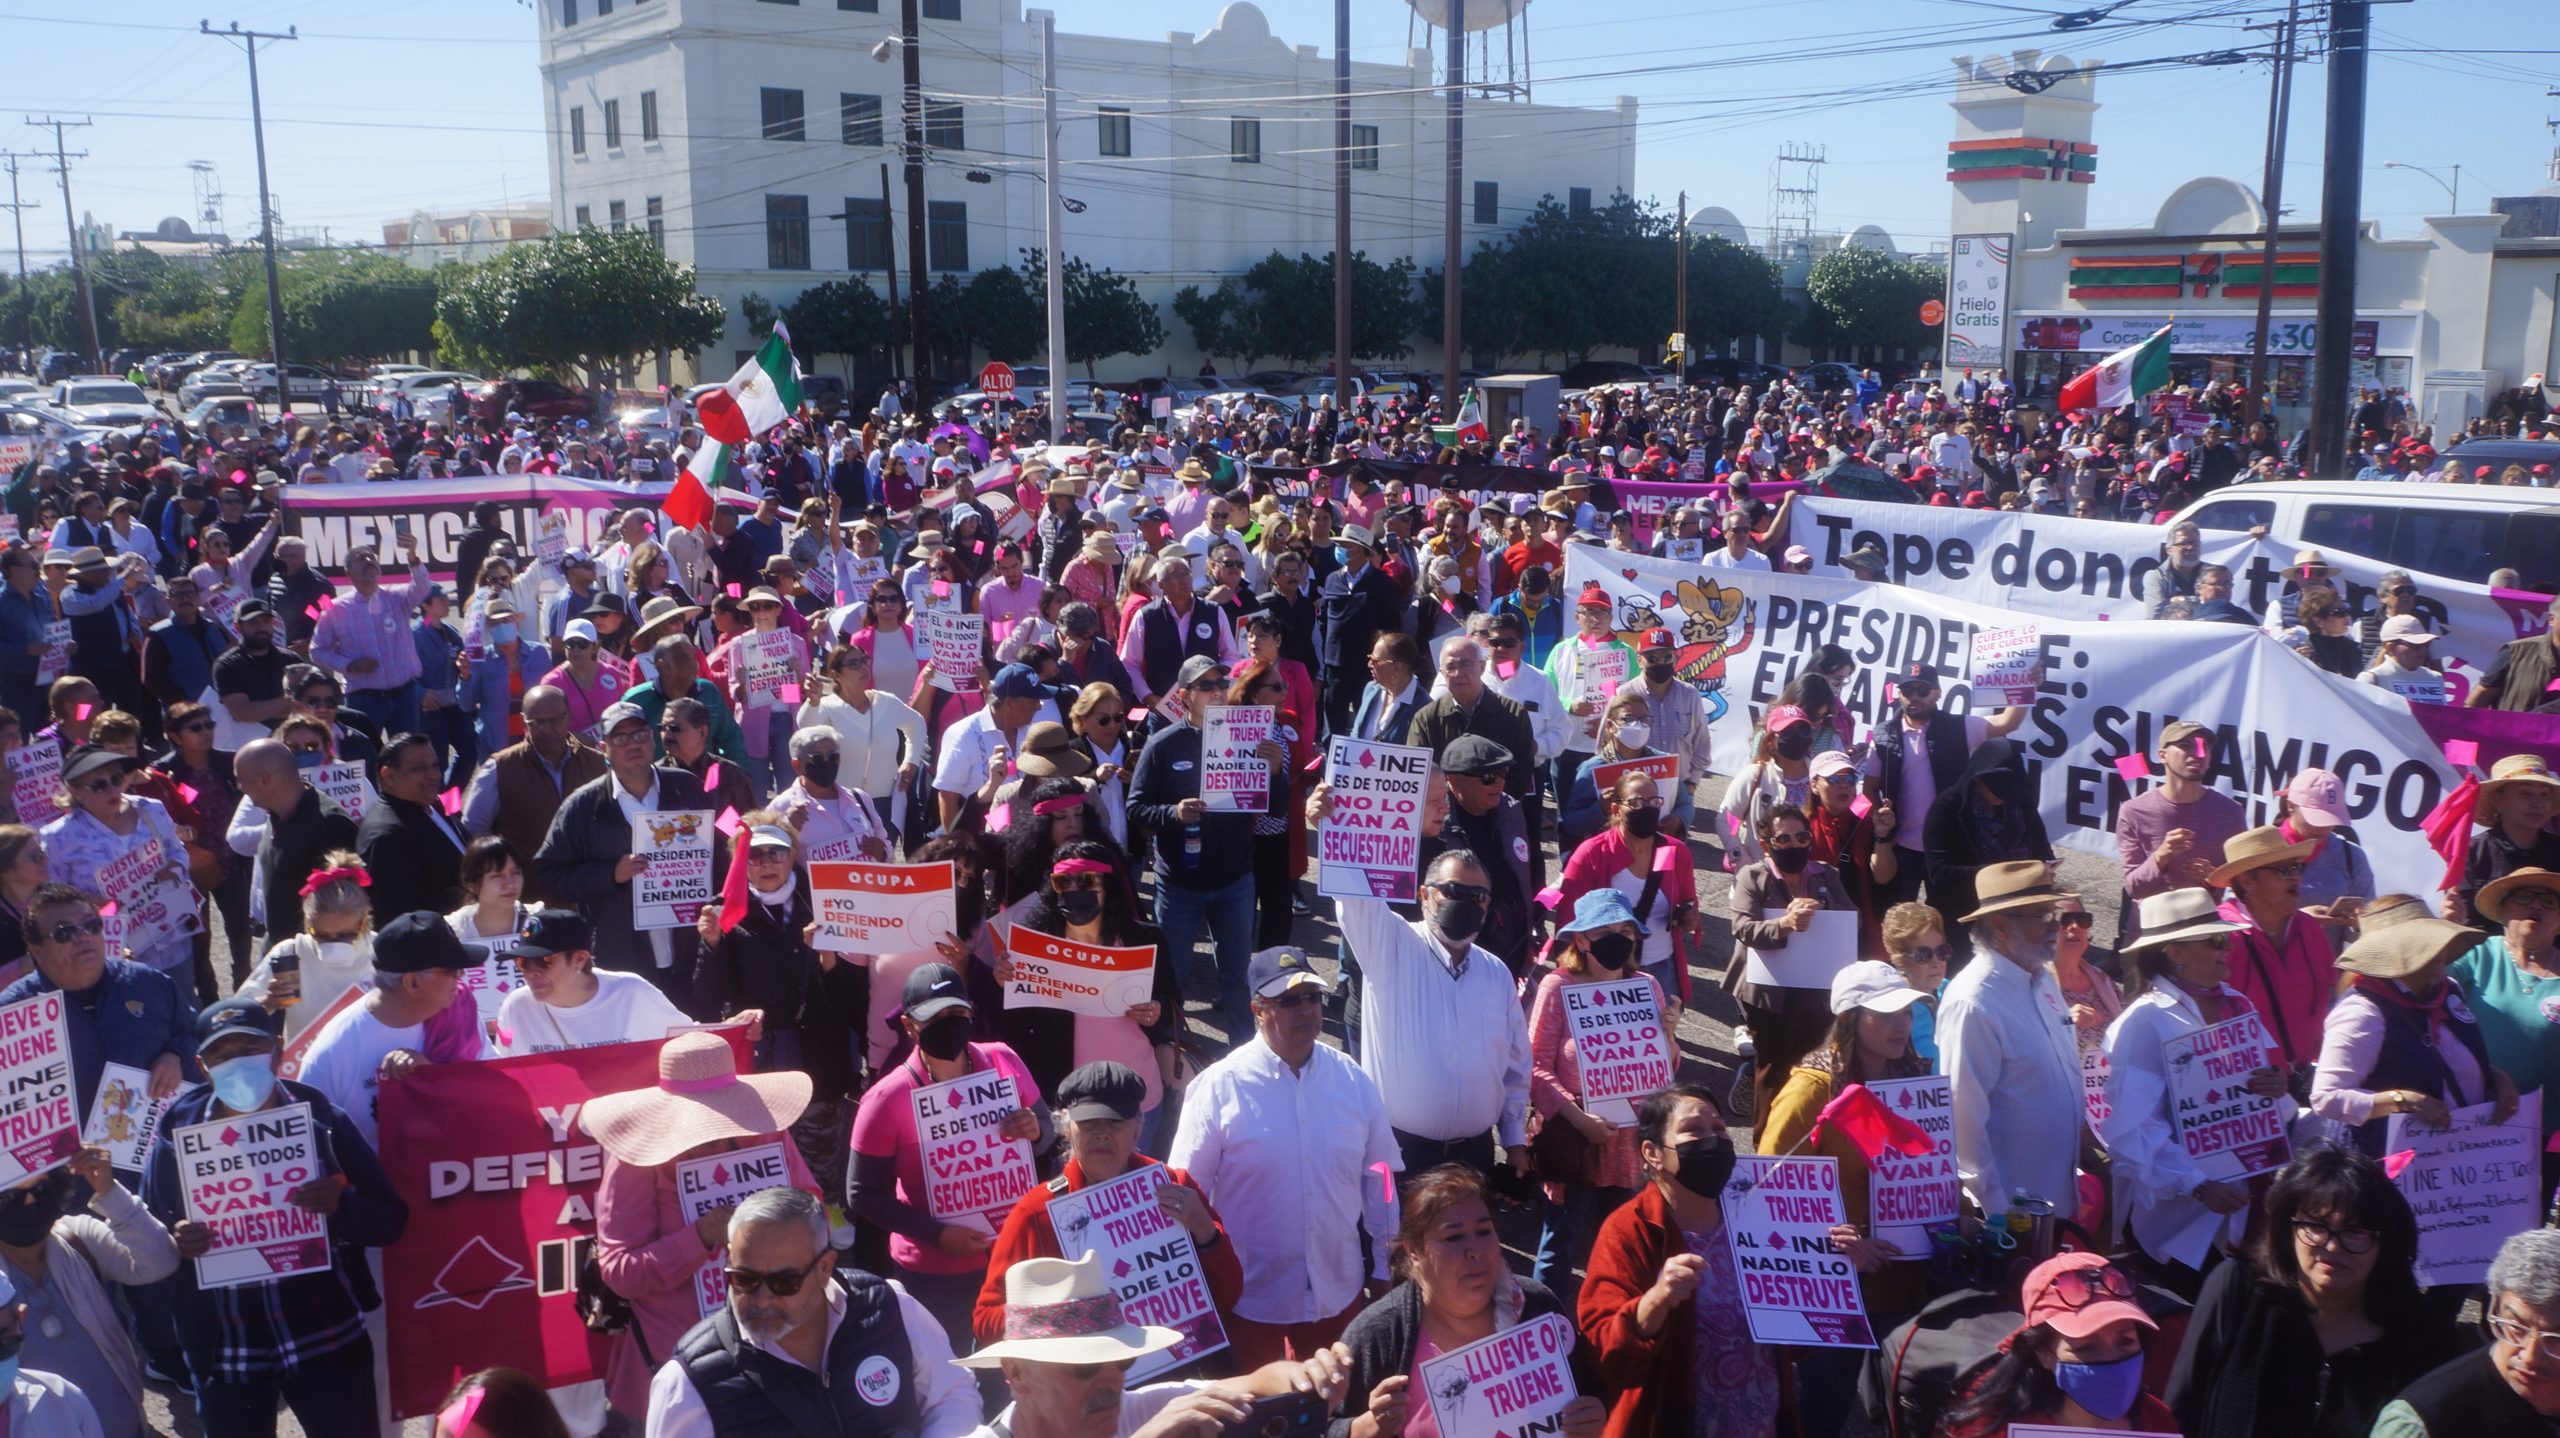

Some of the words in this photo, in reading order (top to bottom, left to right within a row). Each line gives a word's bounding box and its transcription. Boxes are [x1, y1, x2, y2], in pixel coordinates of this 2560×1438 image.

[1960, 297, 1996, 311] Hielo
[1955, 313, 2000, 327] Gratis
[2183, 321, 2205, 329] sabor
[2270, 323, 2317, 350] $30
[983, 374, 1013, 389] ALTO
[1272, 477, 1308, 497] Sin
[300, 507, 535, 567] MEXICLI
[1816, 514, 1974, 586] Tope
[956, 620, 981, 630] INE
[1977, 629, 2016, 644] CUESTE
[2022, 625, 2036, 635] LO
[954, 633, 979, 641] TODOS
[960, 643, 978, 651] LO
[1763, 594, 2089, 699] PRESIDENE:
[1976, 642, 1996, 653] QUE
[1998, 635, 2036, 648] CUESTE
[2007, 648, 2038, 658] INE
[2009, 660, 2026, 668] LO
[1600, 664, 1623, 678] TRUENE
[2418, 686, 2442, 696] INE
[1225, 709, 1262, 725] LLUEVE
[1263, 709, 1271, 723] O
[1229, 726, 1266, 742] TRUENE
[34, 743, 58, 762] INE
[1206, 748, 1218, 759] AL
[1333, 745, 1351, 766] EL
[1379, 754, 1427, 775] INE
[333, 767, 362, 782] INE
[1206, 762, 1246, 771] NADIE
[1250, 762, 1267, 771] LO
[1621, 763, 1668, 777] OCUPA
[2204, 724, 2442, 826] AMIGO
[333, 784, 362, 797] TODOS
[1206, 772, 1267, 790] DESTRUYE
[1334, 774, 1349, 788] ES
[1353, 776, 1370, 791] DE
[1374, 778, 1419, 793] TODOS
[340, 797, 362, 808] LO
[1381, 798, 1415, 814] LO
[1329, 812, 1383, 831] VAN
[1391, 816, 1410, 831] A
[812, 839, 852, 862] CUESTE
[1324, 830, 1416, 867] SECUESTRAR!
[100, 854, 141, 883] CUESTE
[143, 839, 158, 857] LO
[655, 861, 691, 870] NARCO
[105, 876, 129, 899] QUE
[129, 854, 166, 884] CUESTE
[643, 871, 658, 879] SU
[660, 869, 694, 878] AMIGO
[644, 881, 655, 890] EL
[675, 878, 704, 887] INE
[848, 871, 915, 887] OCUPA
[642, 888, 708, 903] ENEMIGO
[823, 898, 855, 911] #YO
[825, 911, 904, 929] DEFIENDO
[825, 928, 870, 941] ALINE
[1045, 943, 1116, 966] OCUPA
[1015, 961, 1048, 975] #YO
[1014, 982, 1063, 999] ALINE
[1015, 972, 1099, 996] DEFIENDO
[46, 998, 60, 1022] O
[1568, 993, 1588, 1011] EL
[1610, 986, 1652, 1006] INE
[1579, 1016, 1594, 1029] ES
[1595, 1013, 1613, 1027] DE
[1613, 1008, 1655, 1024] TODOS
[1580, 1031, 1621, 1051] ¡NO
[1627, 1026, 1658, 1041] LO
[2192, 1022, 2247, 1057] LLUEVE
[2247, 1018, 2259, 1040] O
[1585, 1046, 1636, 1064] VAN
[1643, 1042, 1660, 1057] A
[2084, 1055, 2095, 1069] EL
[2203, 1046, 2262, 1081] TRUENE
[9, 1060, 67, 1096] INE
[1586, 1059, 1670, 1098] SECUESTRAR!
[34, 1082, 67, 1104] LO
[919, 1097, 942, 1119] EL
[968, 1079, 1014, 1108] INE
[1916, 1087, 1949, 1110] INE
[2179, 1097, 2199, 1112] AL
[538, 1103, 581, 1143] Y
[931, 1122, 947, 1141] ES
[950, 1117, 970, 1136] DE
[972, 1104, 1014, 1131] TODOS
[1918, 1115, 1950, 1134] TODOS
[2182, 1104, 2243, 1129] NADIE
[2249, 1097, 2273, 1112] LO
[183, 1132, 212, 1155] EL
[247, 1115, 307, 1144] INE
[2185, 1109, 2281, 1157] DESTRUYE
[195, 1160, 216, 1177] ES
[221, 1155, 244, 1172] DE
[247, 1144, 306, 1168] TODOS
[928, 1138, 977, 1168] ¡NO
[934, 1154, 993, 1180] VAN
[1001, 1147, 1021, 1165] A
[429, 1144, 602, 1200] DEFIE
[683, 1170, 707, 1195] EL
[734, 1156, 784, 1183] INE
[1753, 1163, 1817, 1191] LLUEVE
[1821, 1164, 1835, 1192] O
[1880, 1161, 1933, 1182] VAN
[1940, 1158, 1953, 1176] A
[2413, 1168, 2442, 1191] INE
[2452, 1165, 2478, 1187] NO
[2482, 1162, 2508, 1185] SE
[192, 1177, 253, 1204] ¡NO
[264, 1166, 308, 1188] LO
[933, 1164, 1035, 1215] SECUESTRAR!
[198, 1191, 273, 1216] VAN
[1085, 1175, 1153, 1221] LLUEVE
[1765, 1195, 1836, 1225] TRUENE
[207, 1207, 321, 1249] ECUESTRAR!
[1104, 1204, 1175, 1249] TRUENE
[1736, 1231, 1759, 1249] AL
[1136, 1237, 1190, 1273] INE
[1741, 1255, 1812, 1274] NADIE
[1818, 1260, 1848, 1276] LO
[1121, 1275, 1161, 1301] DIE
[1166, 1262, 1194, 1283] LO
[1745, 1272, 1859, 1312] DESTRUYE
[1123, 1278, 1208, 1328] STRUYE
[1465, 1329, 1539, 1385] LLUEVE
[1540, 1322, 1558, 1355] O
[1483, 1362, 1565, 1419] TRUENE
